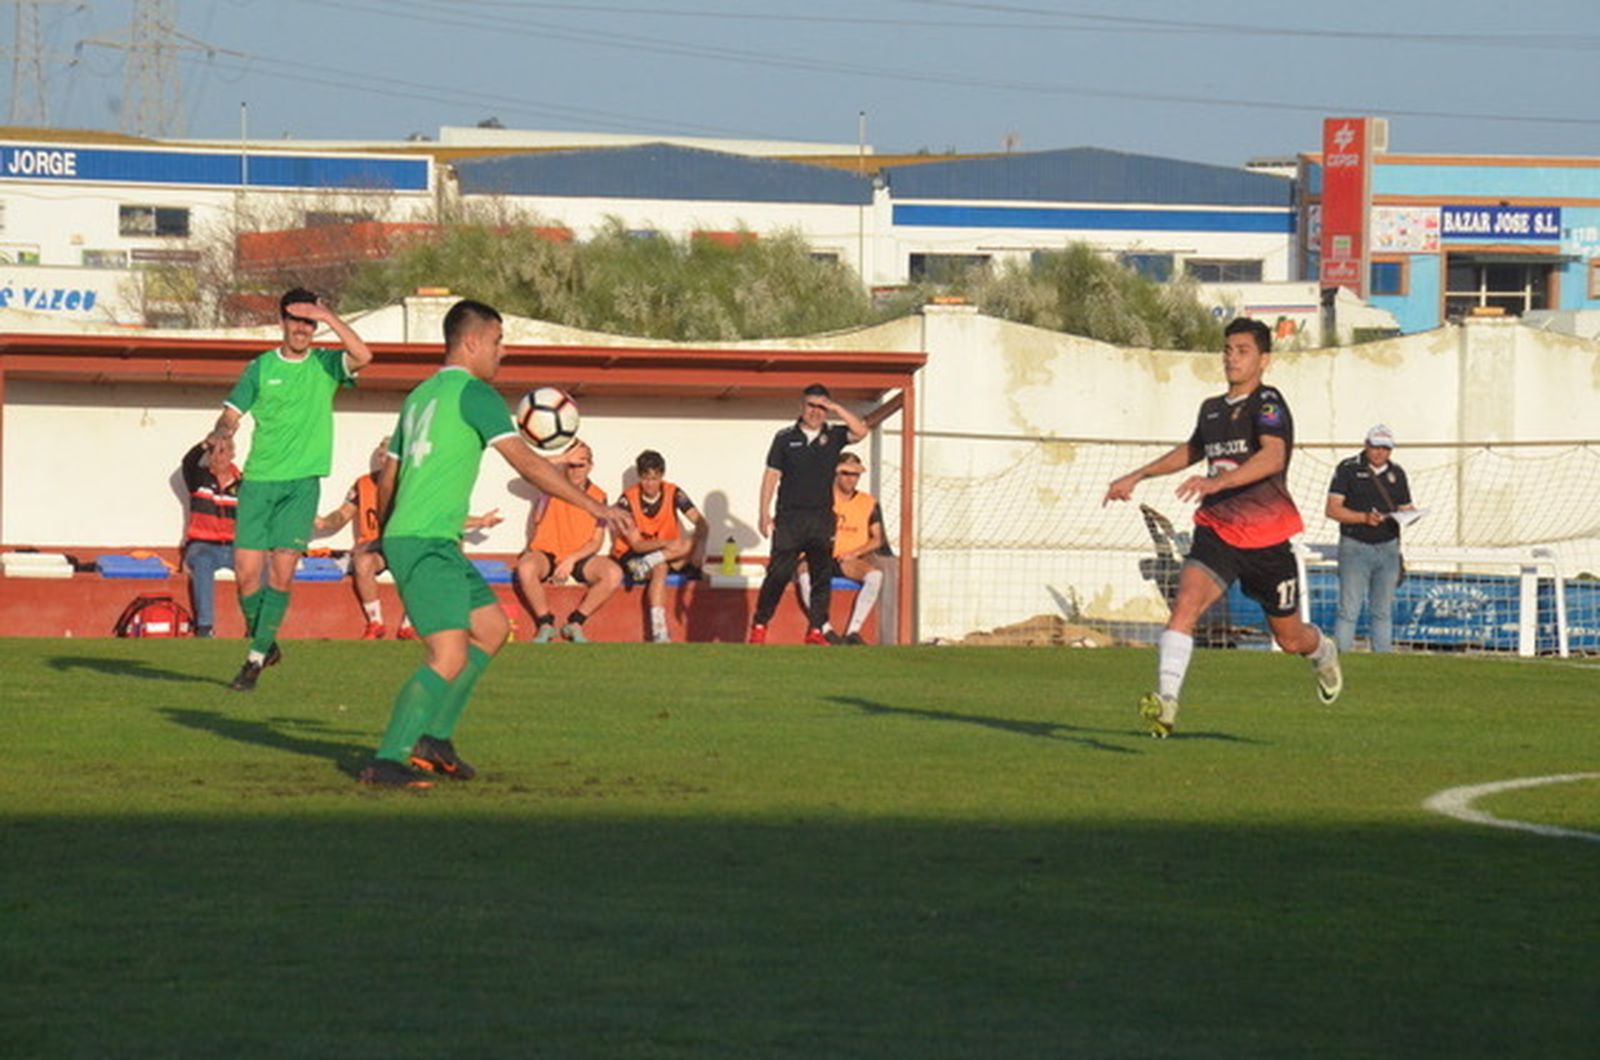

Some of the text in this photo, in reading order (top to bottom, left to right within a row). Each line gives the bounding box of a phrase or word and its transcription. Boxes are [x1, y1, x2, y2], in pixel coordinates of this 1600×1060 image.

[8, 149, 77, 175] JORGE
[1443, 211, 1491, 232] BAZAR
[402, 398, 438, 467] 14
